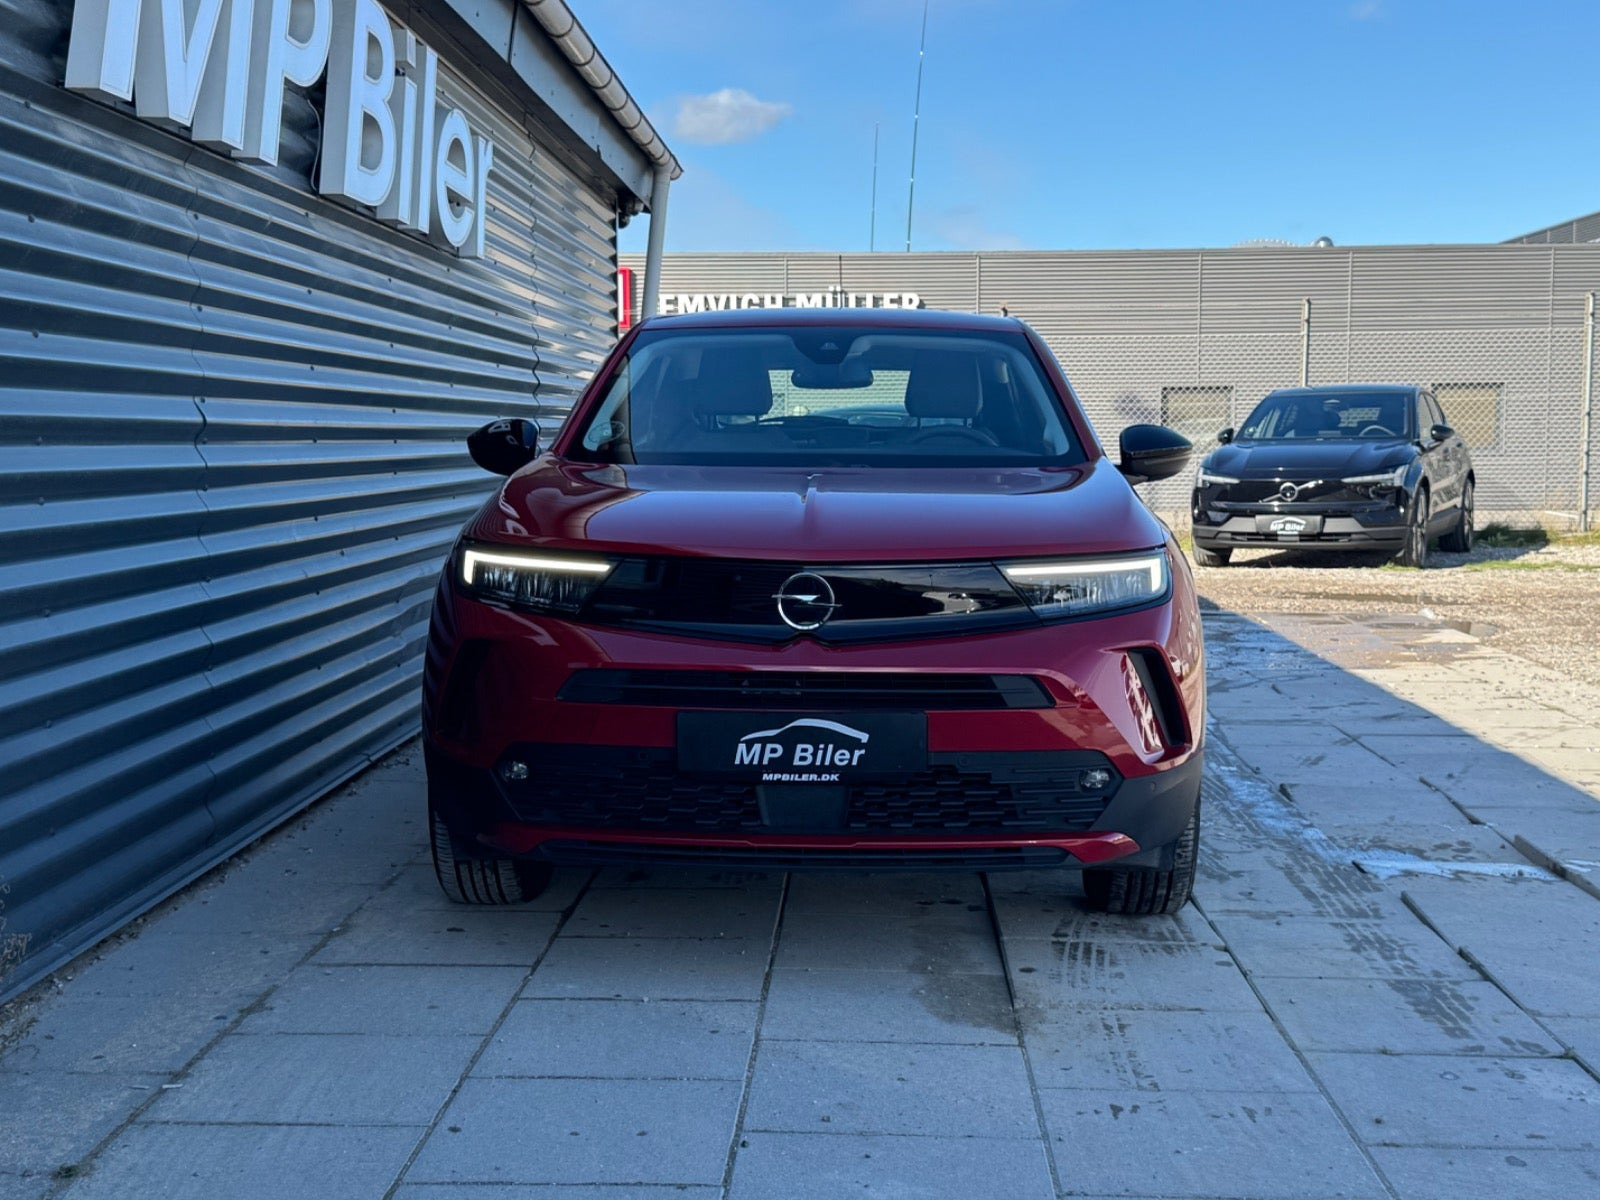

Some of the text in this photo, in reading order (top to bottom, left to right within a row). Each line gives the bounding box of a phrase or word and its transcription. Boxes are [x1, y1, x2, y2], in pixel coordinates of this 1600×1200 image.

[66, 0, 494, 259] MP Biler
[657, 293, 783, 316] EMVIGH
[734, 743, 866, 766] MP Biler
[762, 773, 840, 782] MPBILER.DK
